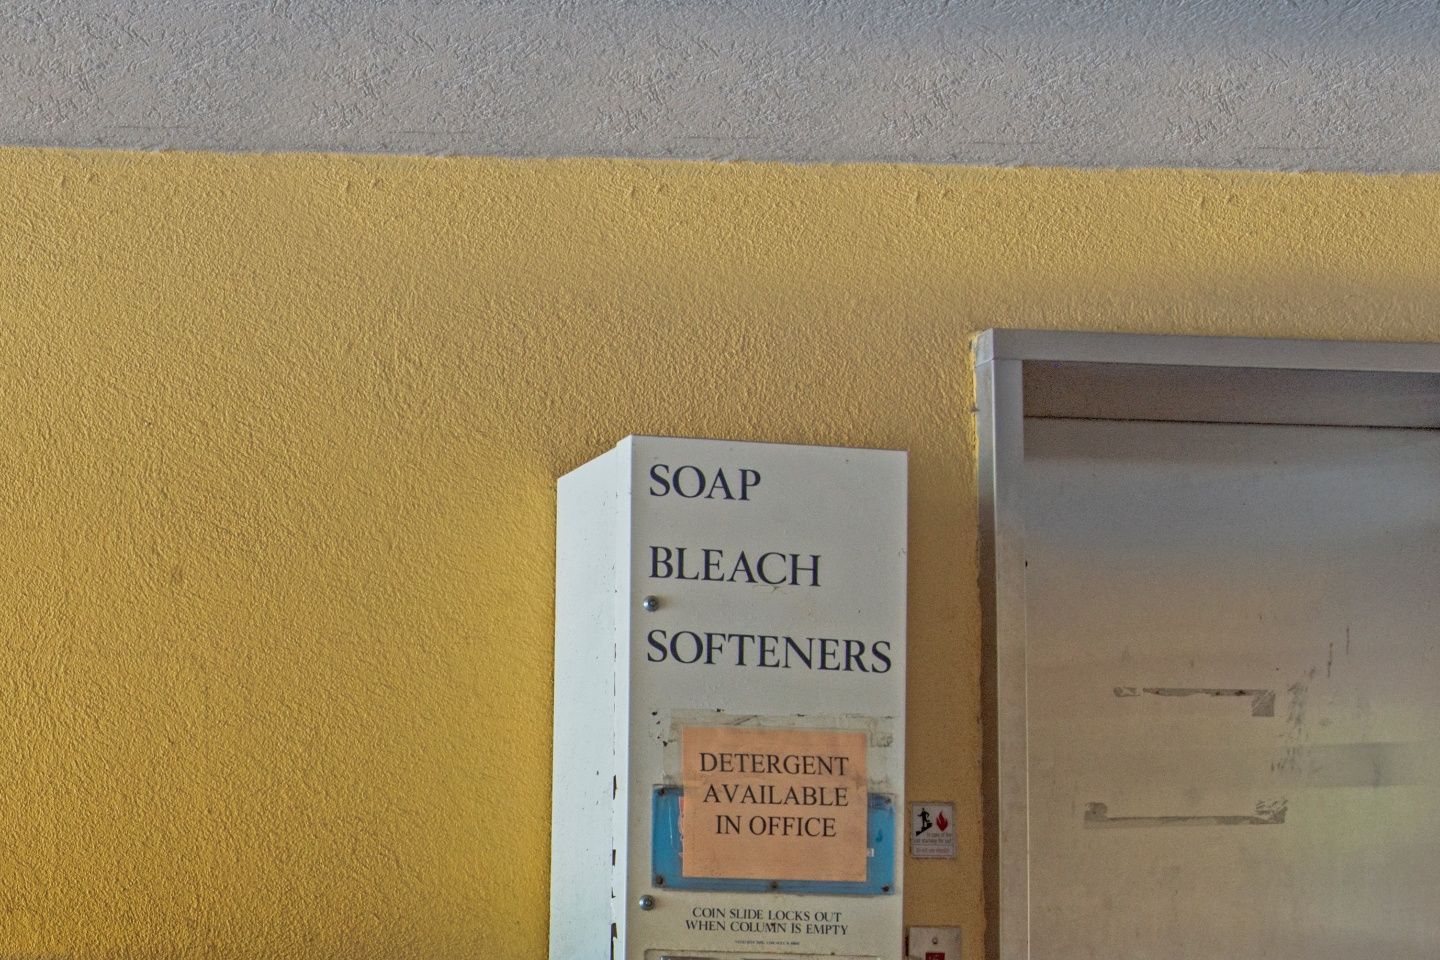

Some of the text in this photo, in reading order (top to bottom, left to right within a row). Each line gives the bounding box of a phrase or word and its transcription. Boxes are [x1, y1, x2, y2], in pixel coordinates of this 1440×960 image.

[649, 463, 761, 501] SOAP
[648, 546, 822, 587] BLEACH
[647, 629, 891, 674] SOFTENERS
[699, 752, 849, 776] DETERGENT
[703, 784, 849, 807] AVAILABLE
[716, 814, 837, 837] IN OFFICE
[692, 907, 843, 923] COIN SLIDE LOCKS OUT
[685, 919, 849, 936] WHEN COLUMN IS EMPTY
